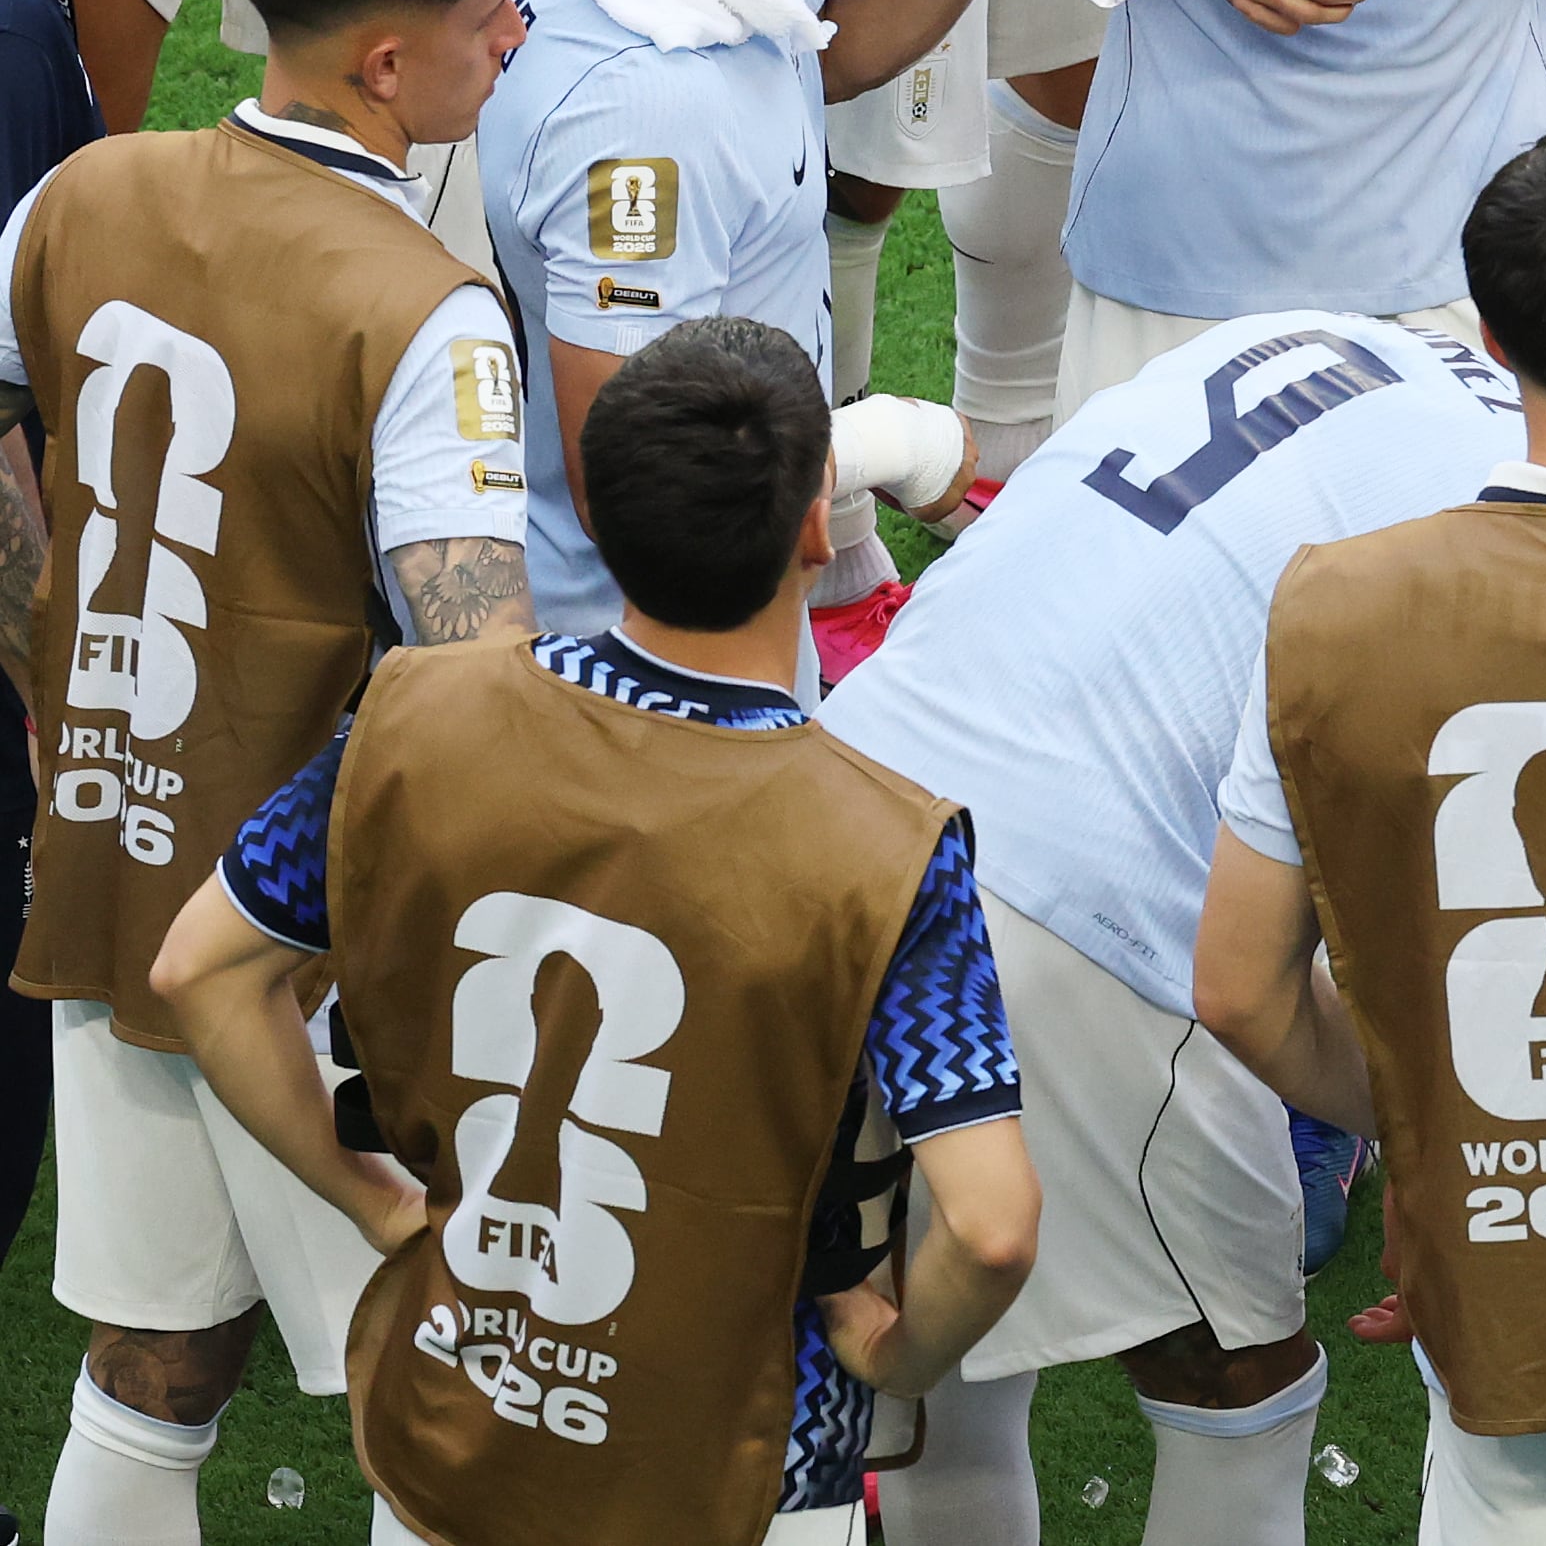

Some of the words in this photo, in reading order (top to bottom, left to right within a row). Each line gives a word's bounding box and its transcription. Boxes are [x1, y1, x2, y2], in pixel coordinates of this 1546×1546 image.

[612, 242, 657, 253] 2026
[613, 289, 656, 301] DEBUT
[1082, 328, 1404, 536] 9
[1092, 910, 1159, 961] AERO-FIT
[413, 1301, 609, 1446] 2026
[528, 1336, 618, 1384] CUP
